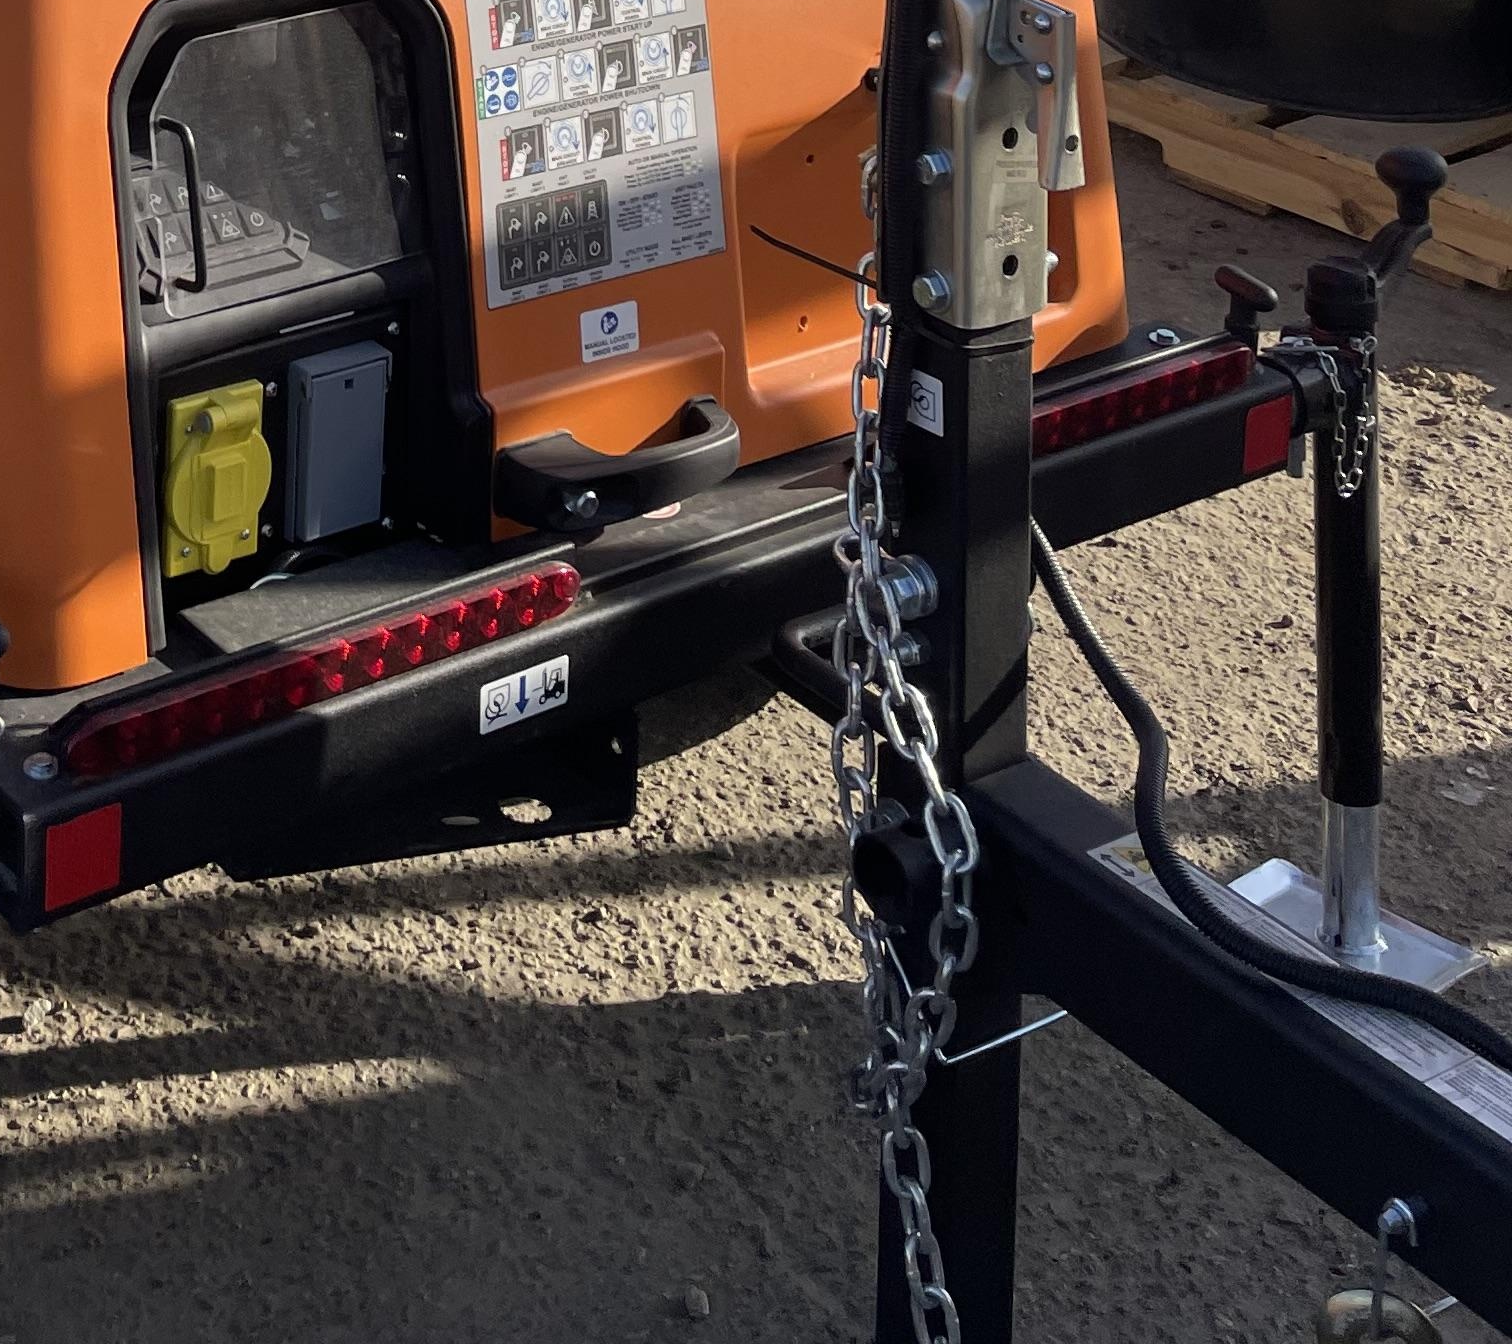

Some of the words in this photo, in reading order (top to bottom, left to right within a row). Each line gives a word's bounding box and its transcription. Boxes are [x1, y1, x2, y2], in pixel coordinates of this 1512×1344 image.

[598, 27, 621, 37] POWER
[622, 23, 642, 32] START
[644, 20, 652, 28] UP
[624, 84, 660, 97] SHUTDOWN
